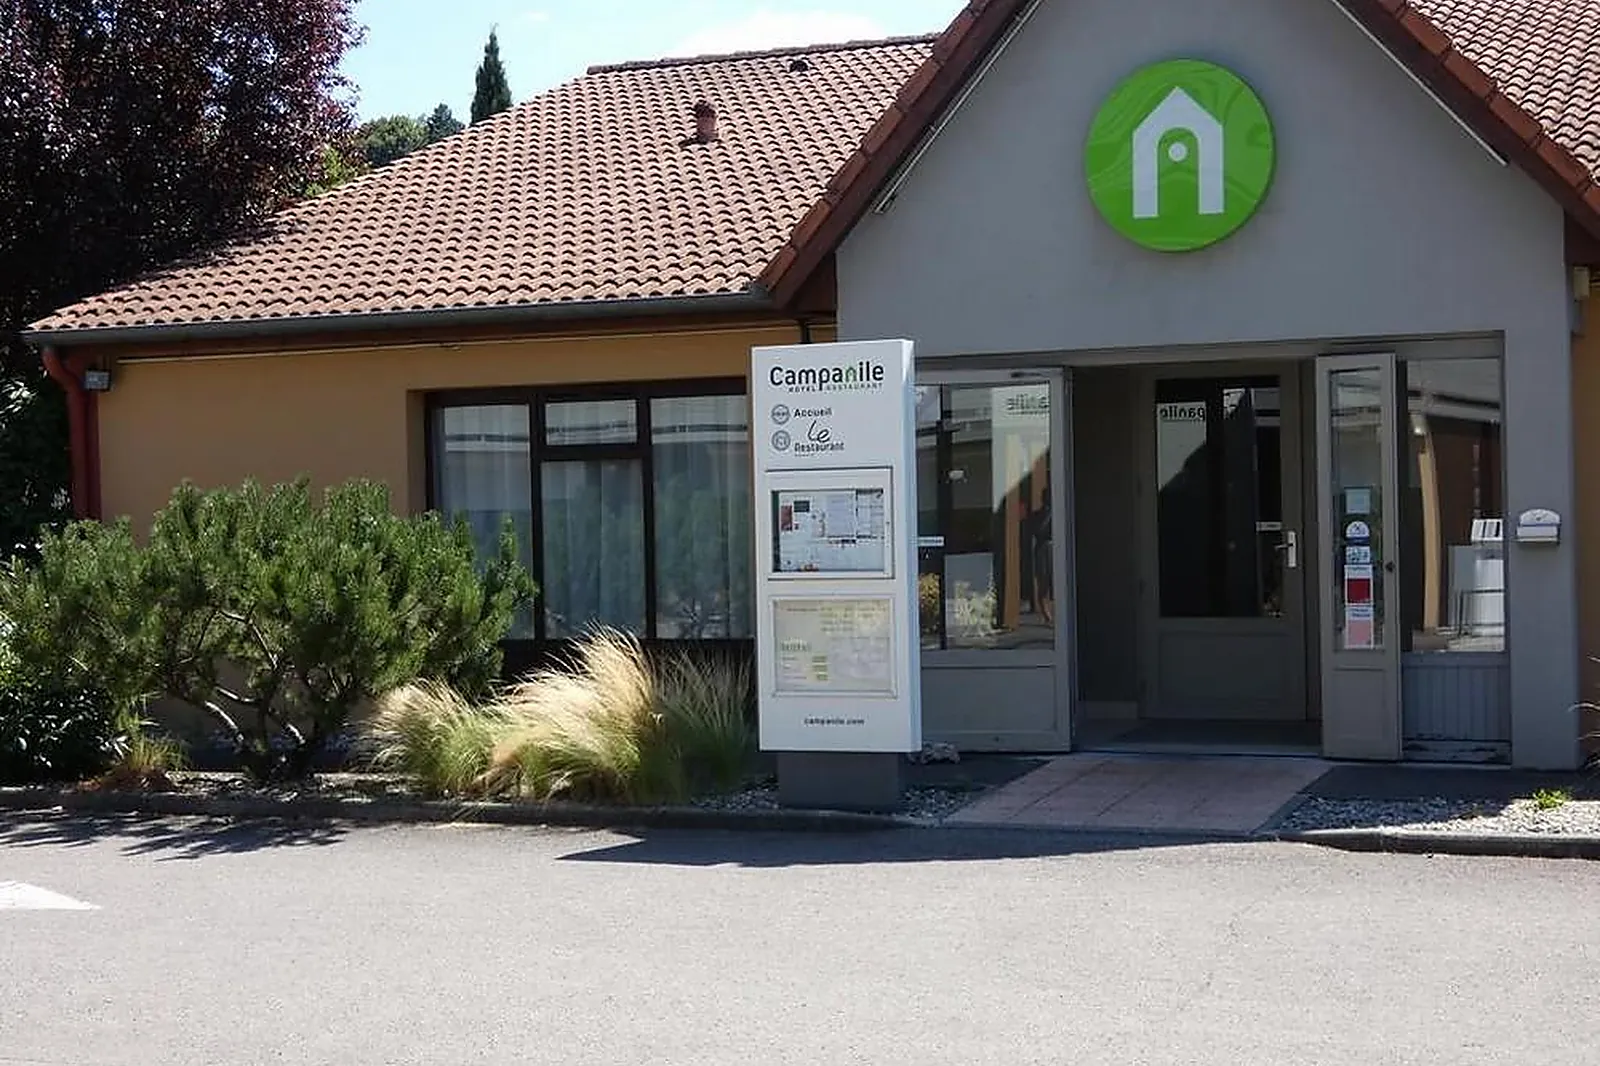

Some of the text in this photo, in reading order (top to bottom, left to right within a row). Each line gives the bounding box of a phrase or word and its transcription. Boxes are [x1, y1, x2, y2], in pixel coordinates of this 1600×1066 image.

[769, 361, 884, 391] Campanile
[794, 407, 832, 418] Accueil
[794, 442, 845, 452] Restaurant
[803, 716, 865, 726] campanile.com
